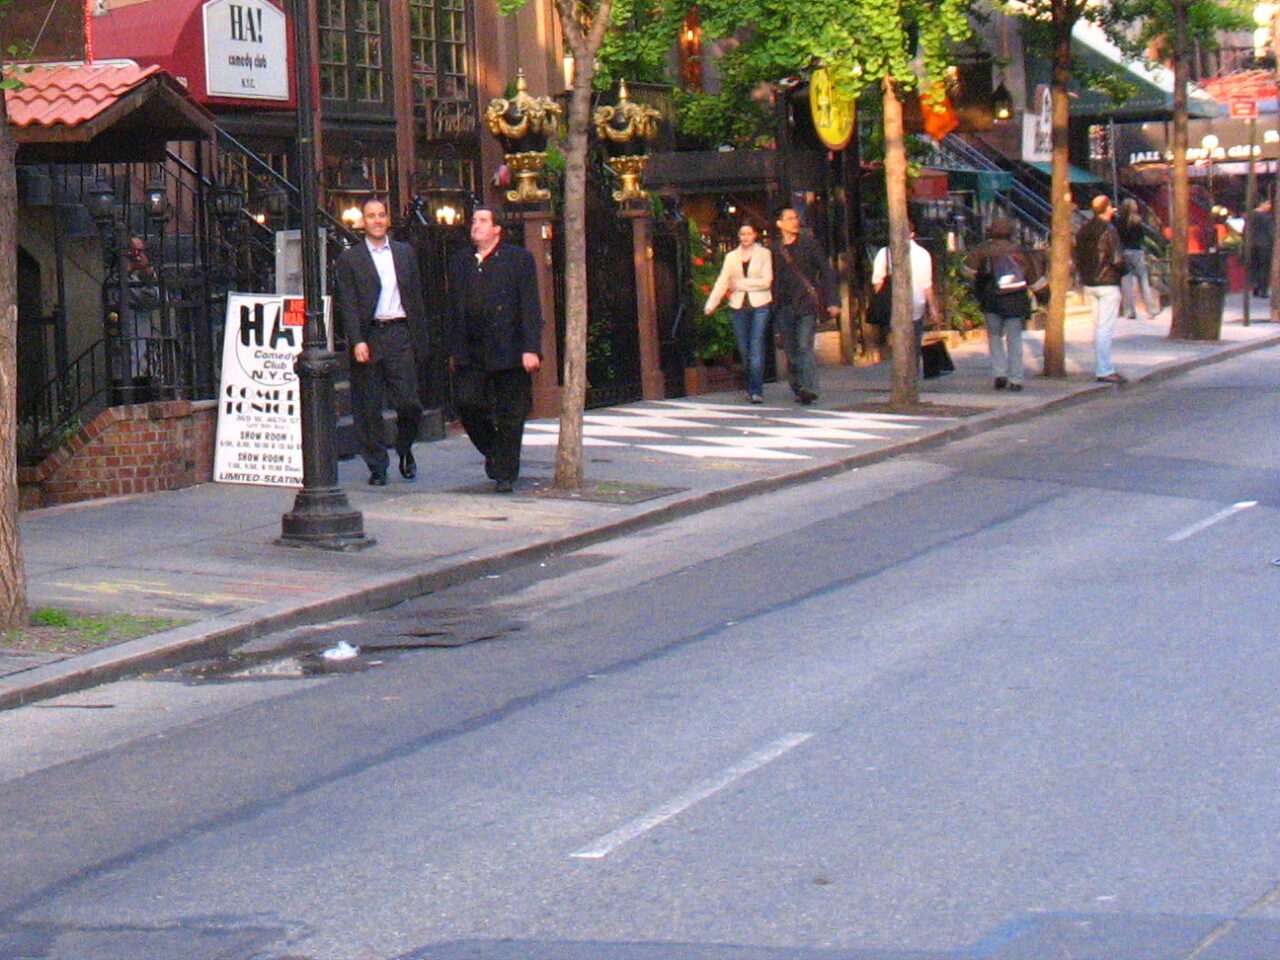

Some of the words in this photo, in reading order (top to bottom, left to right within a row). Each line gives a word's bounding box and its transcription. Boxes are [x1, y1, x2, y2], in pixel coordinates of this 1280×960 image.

[228, 4, 264, 44] HA!
[228, 53, 253, 71] comedy
[254, 54, 267, 68] club
[254, 350, 298, 363] Comedy
[263, 360, 287, 370] Club
[240, 431, 262, 441] SHOW
[265, 432, 287, 442] ROOM
[238, 451, 259, 462] SHOW
[262, 452, 285, 463] ROOM
